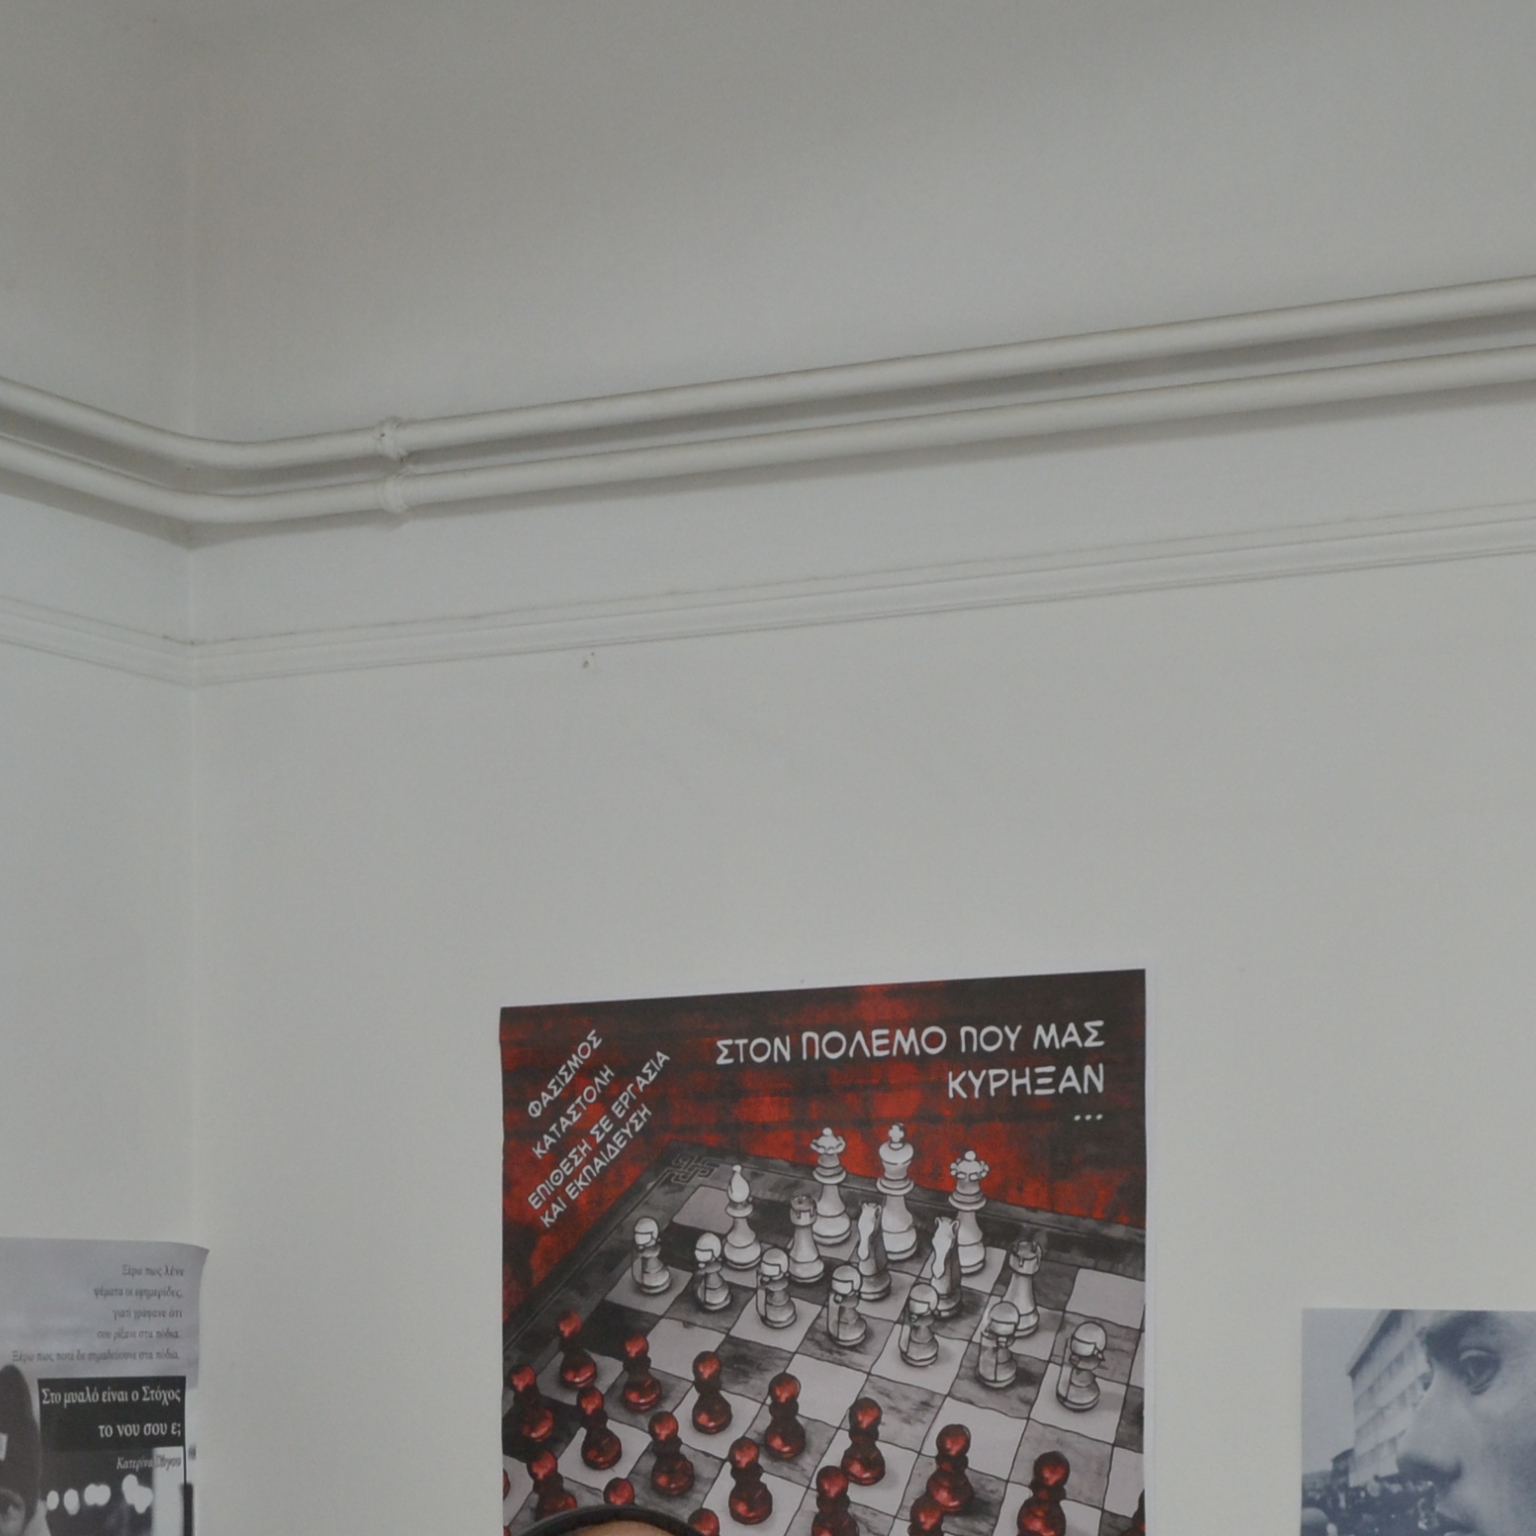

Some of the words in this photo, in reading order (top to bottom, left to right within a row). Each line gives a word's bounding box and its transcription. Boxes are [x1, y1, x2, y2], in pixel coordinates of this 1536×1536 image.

[528, 1029, 602, 1118] ΦΑΣΙΣΜΟΣ
[716, 1034, 791, 1065] ΣΤΟΝ
[802, 1025, 947, 1061] ΠΟΛΕΜΟ
[960, 1024, 1022, 1053] ΠΟΥ
[1033, 1019, 1105, 1050] ΜΑΣ
[531, 1064, 614, 1159] ΚΑΤΑΣΤΟΛΗ
[948, 1062, 1104, 1099] ΚΥΡΗΞΑΝ
[528, 1138, 592, 1210] ΕΠΙΘΕΣΗ
[590, 1115, 613, 1143] ΣΕ
[611, 1051, 670, 1119] ΕΡΓΑΣΙΑ
[540, 1197, 567, 1228] ΚΑΙ
[565, 1103, 652, 1200] ΕΚΠΑΙΔΕΥΣΗ
[42, 1388, 61, 1404] Στο
[63, 1386, 99, 1408] μυαλό
[102, 1385, 128, 1401] είναι
[142, 1385, 181, 1406] Στόχος
[98, 1423, 113, 1438] το
[117, 1422, 140, 1437] νου
[143, 1421, 167, 1436] σου
